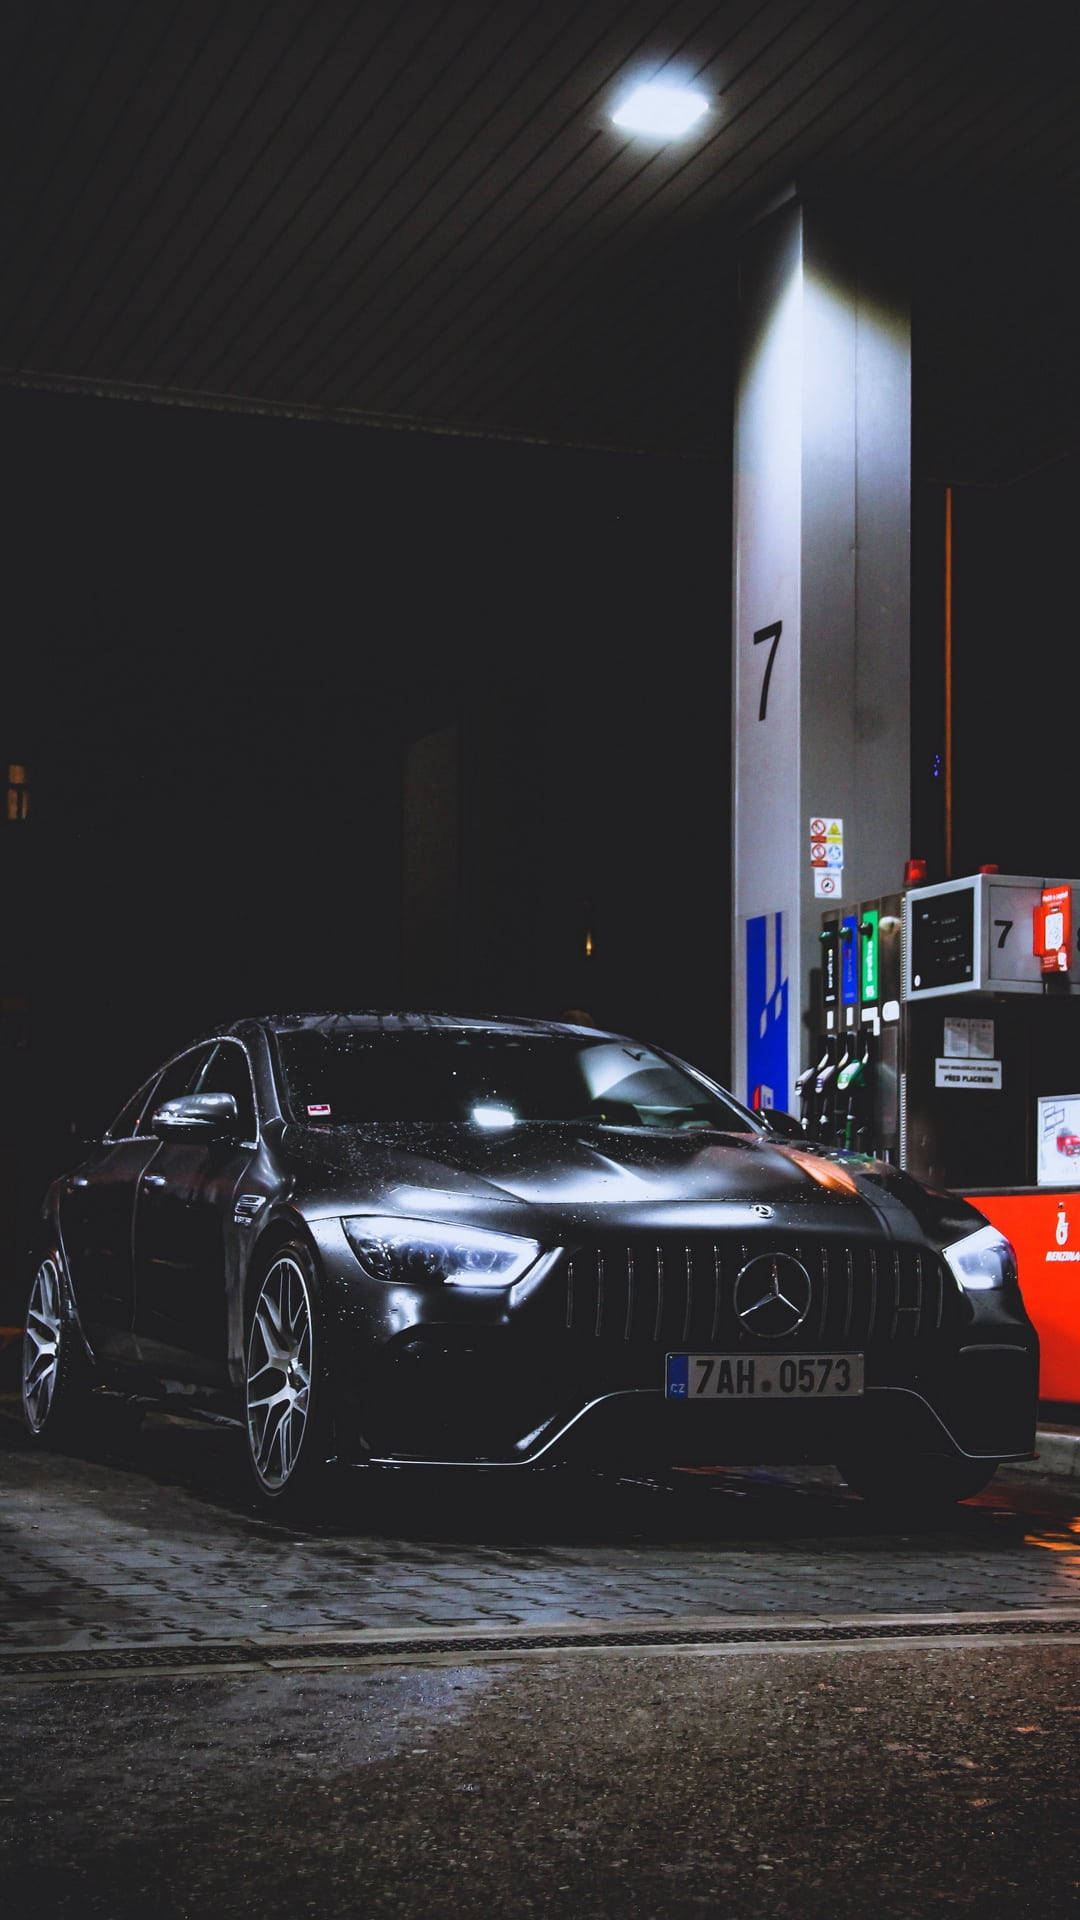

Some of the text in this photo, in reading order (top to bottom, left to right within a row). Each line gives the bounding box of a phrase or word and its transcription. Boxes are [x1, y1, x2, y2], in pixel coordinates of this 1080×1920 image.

[754, 620, 782, 721] 7
[994, 920, 1013, 949] 7
[670, 1384, 686, 1394] CZ
